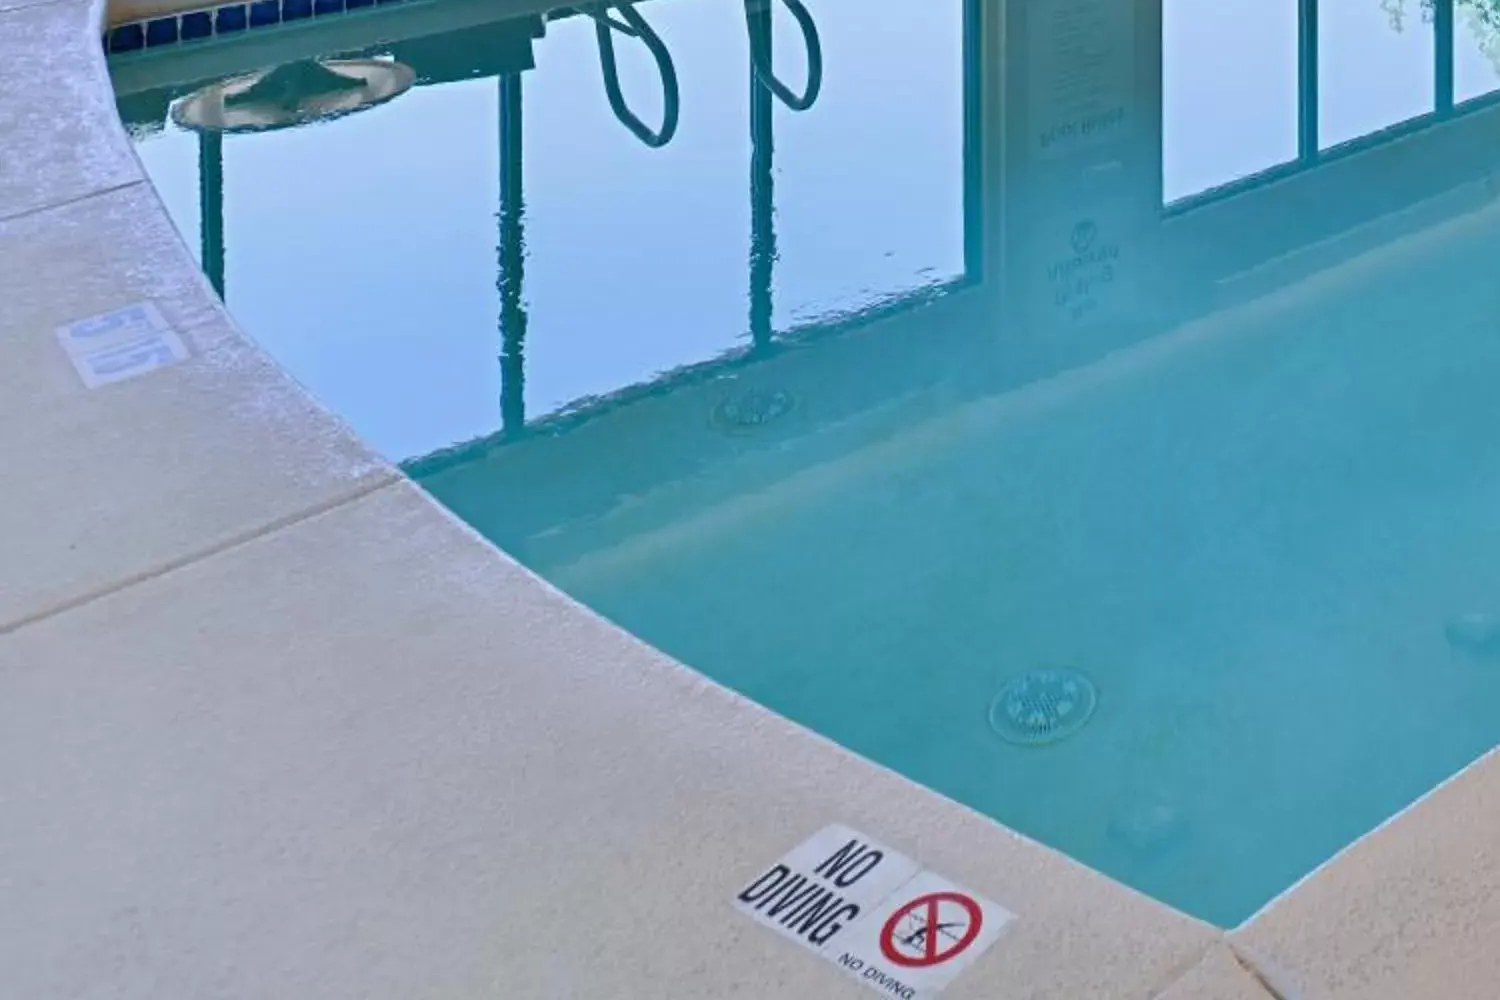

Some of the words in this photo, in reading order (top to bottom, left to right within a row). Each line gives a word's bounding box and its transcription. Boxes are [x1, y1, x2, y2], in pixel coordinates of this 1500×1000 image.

[812, 839, 884, 890] NO
[736, 863, 861, 948] DIVING
[837, 953, 865, 972] NO
[862, 966, 917, 1000] DIVING
